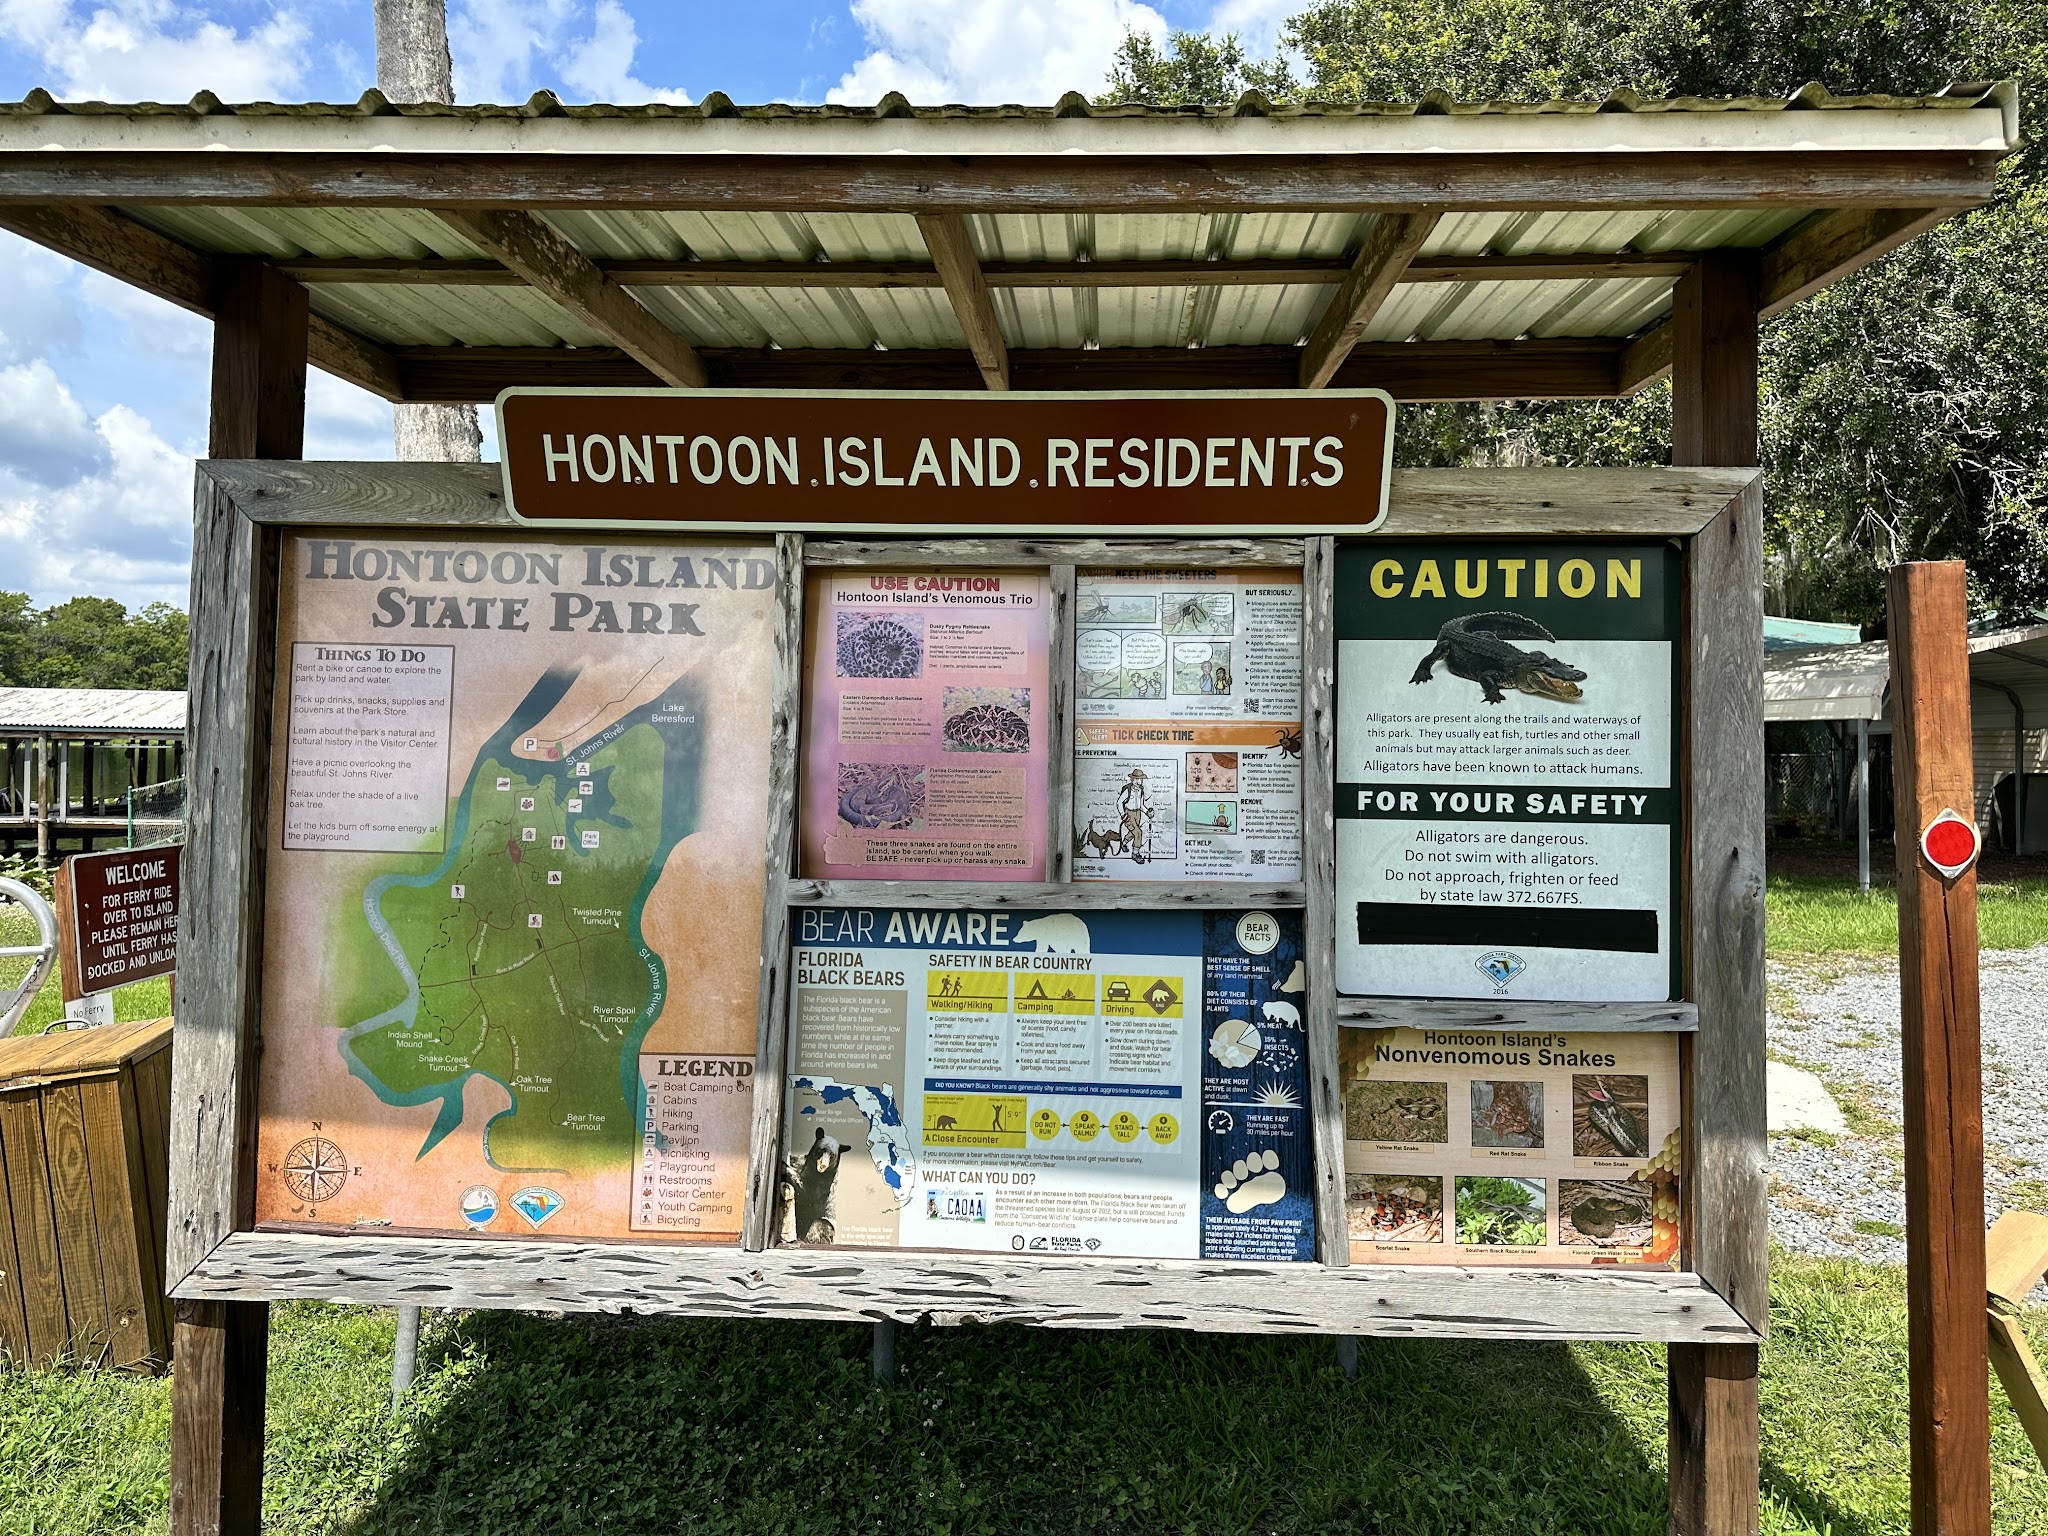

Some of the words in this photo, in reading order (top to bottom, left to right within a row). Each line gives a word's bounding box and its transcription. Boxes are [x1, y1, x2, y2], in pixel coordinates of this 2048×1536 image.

[543, 434, 799, 485] HONTOON
[823, 437, 1022, 489] ISLAND
[1047, 437, 1344, 489] RESIDENTS
[870, 576, 908, 591] USE
[914, 577, 1001, 592] CAUTION
[1370, 559, 1641, 598] CAUTION
[837, 591, 888, 602] Hontoon
[892, 592, 939, 603] Island's
[942, 593, 1006, 604] Venomous
[1010, 593, 1033, 605] Trio
[295, 663, 316, 673] Rent
[326, 664, 344, 673] bike
[345, 665, 355, 673] or
[395, 666, 426, 675] explore
[428, 666, 442, 675] the
[293, 694, 312, 706] Pick
[314, 696, 326, 705] up
[327, 695, 355, 705] drinks,
[357, 697, 389, 706] snacks,
[391, 697, 426, 707] supplies
[428, 698, 445, 706] and
[662, 703, 685, 712] Lake
[651, 713, 695, 723] Beresford
[1112, 729, 1134, 741] TICK
[1136, 730, 1169, 741] CHECK
[1171, 730, 1194, 741] TIME
[566, 756, 579, 766] St.
[580, 739, 603, 757] Johns
[603, 724, 625, 741] River
[1358, 790, 1418, 811] FOR
[1430, 792, 1514, 813] YOUR
[1526, 793, 1647, 815] SAFETY
[866, 839, 888, 847] These
[950, 841, 971, 849] found
[1415, 829, 1480, 845] Alligators
[1484, 834, 1506, 844] are
[1510, 831, 1588, 847] dangerous.
[1405, 849, 1424, 862] Do
[1428, 851, 1451, 862] not
[1455, 851, 1491, 863] swim
[1495, 851, 1526, 864] with
[1531, 851, 1598, 868] alligators.
[105, 860, 166, 886] WELCOME
[102, 894, 121, 909] FOR
[123, 889, 151, 905] FERRY
[154, 885, 172, 900] RIDE
[1420, 888, 1437, 903] by
[1440, 890, 1474, 902] state
[1479, 889, 1503, 902] law
[1507, 890, 1582, 904] 372.667FS.
[103, 909, 127, 925] OVER
[129, 906, 141, 920] TO
[143, 901, 173, 917] ISLAND
[572, 907, 602, 916] Twisted
[604, 908, 622, 917] Pine
[582, 916, 612, 925] Turnout
[91, 925, 128, 945] PLEASE
[129, 918, 162, 937] REMAIN
[164, 915, 179, 929] HER
[802, 910, 874, 942] BEAR
[884, 912, 1009, 946] AWARE
[1246, 923, 1269, 932] BEAR
[366, 899, 383, 933] Hontoon
[381, 932, 398, 955] Dead
[395, 954, 411, 976] River
[1244, 932, 1271, 942] FACTS
[102, 942, 129, 959] UNTIL
[131, 935, 158, 953] FERRY
[161, 930, 178, 946] HAS
[87, 959, 125, 980] DOCKED
[129, 955, 147, 970] AND
[149, 950, 177, 964] UNLOA
[798, 951, 864, 968] FLORIDA
[929, 954, 976, 967] SAFETY
[979, 955, 992, 968] IN
[995, 955, 1029, 969] BEAR
[1033, 956, 1092, 971] COUNTRY
[797, 969, 849, 985] BLACK
[853, 970, 905, 986] BEARS
[1493, 987, 1509, 995] 2016
[73, 1010, 83, 1018] No
[84, 1004, 104, 1016] Ferry
[593, 1005, 614, 1016] River
[616, 1006, 636, 1016] Spoil
[931, 1000, 993, 1012] Walking/Hiking
[1017, 1002, 1054, 1013] Camping
[1106, 1004, 1134, 1016] Driving
[599, 1014, 629, 1023] Turnout
[387, 1030, 411, 1039] Indian
[412, 1031, 433, 1041] Shell
[1424, 1031, 1496, 1046] Hontoon
[1501, 1033, 1567, 1047] Island's
[396, 1039, 423, 1049] Mound
[418, 1054, 444, 1065] Snake
[444, 1055, 468, 1065] Creek
[1375, 1045, 1531, 1065] Nonvenomous
[1538, 1049, 1616, 1067] Snakes
[428, 1062, 458, 1071] Turnout
[657, 1060, 753, 1078] LEGEND
[663, 1095, 698, 1105] Cabins
[662, 1108, 693, 1121] Hiking
[661, 1121, 699, 1133] Parking
[660, 1135, 700, 1145] Pavilion
[932, 1133, 955, 1143] Close
[957, 1134, 999, 1144] Encounter
[660, 1148, 710, 1160] Picnicking
[660, 1161, 715, 1174] Playground
[659, 1174, 712, 1186] Restrooms
[922, 1170, 957, 1183] WHAT
[959, 1171, 983, 1184] CAN
[985, 1172, 1009, 1184] YOU
[1012, 1172, 1036, 1185] DO?
[658, 1188, 689, 1198] Visitor
[691, 1187, 726, 1199] Center
[658, 1201, 686, 1211] Youth
[688, 1202, 733, 1215] Camping
[657, 1214, 701, 1228] Bicycling
